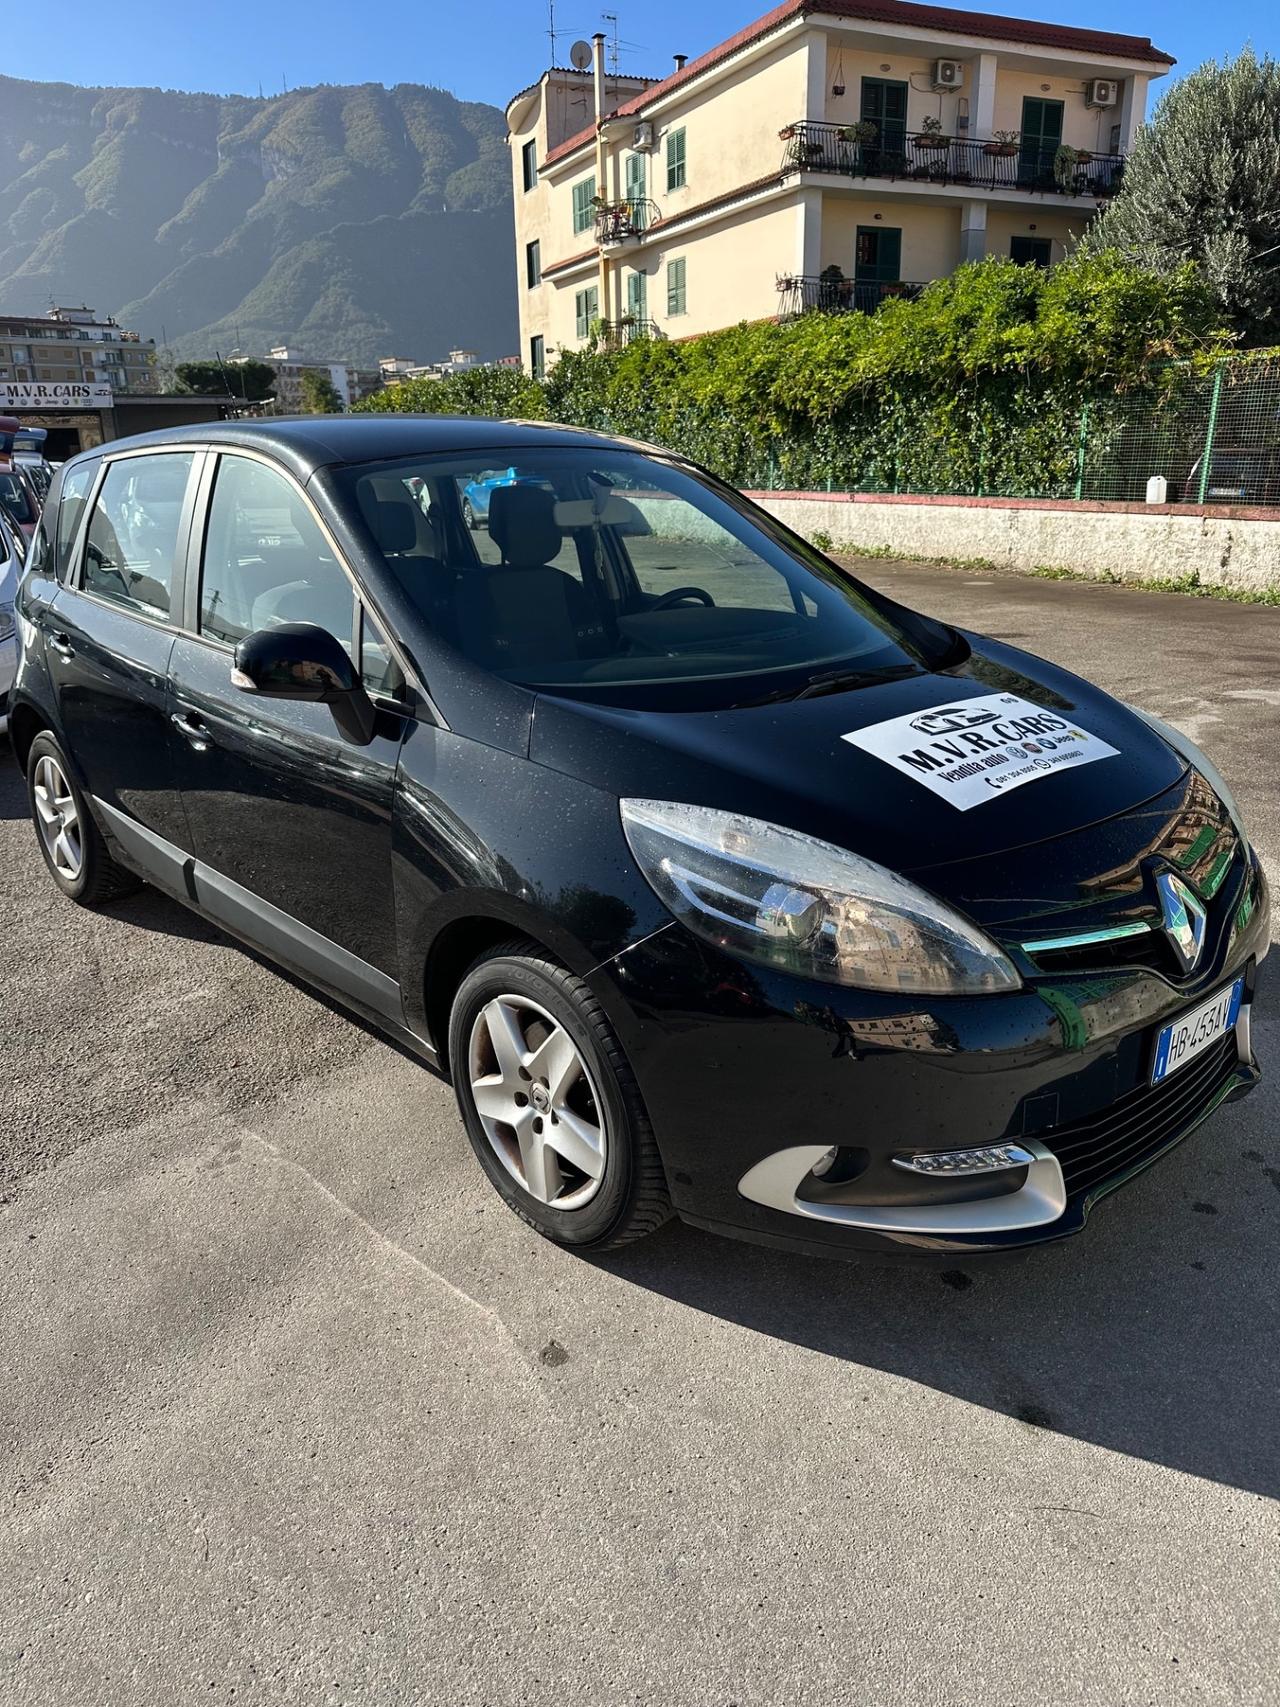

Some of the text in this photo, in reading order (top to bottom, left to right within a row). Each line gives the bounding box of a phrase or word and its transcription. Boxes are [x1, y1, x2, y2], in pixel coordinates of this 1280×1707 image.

[7, 385, 91, 398] M.V.R.CARS
[897, 713, 1068, 774] M.V.R.CARS
[936, 753, 1010, 783] Vendita auto
